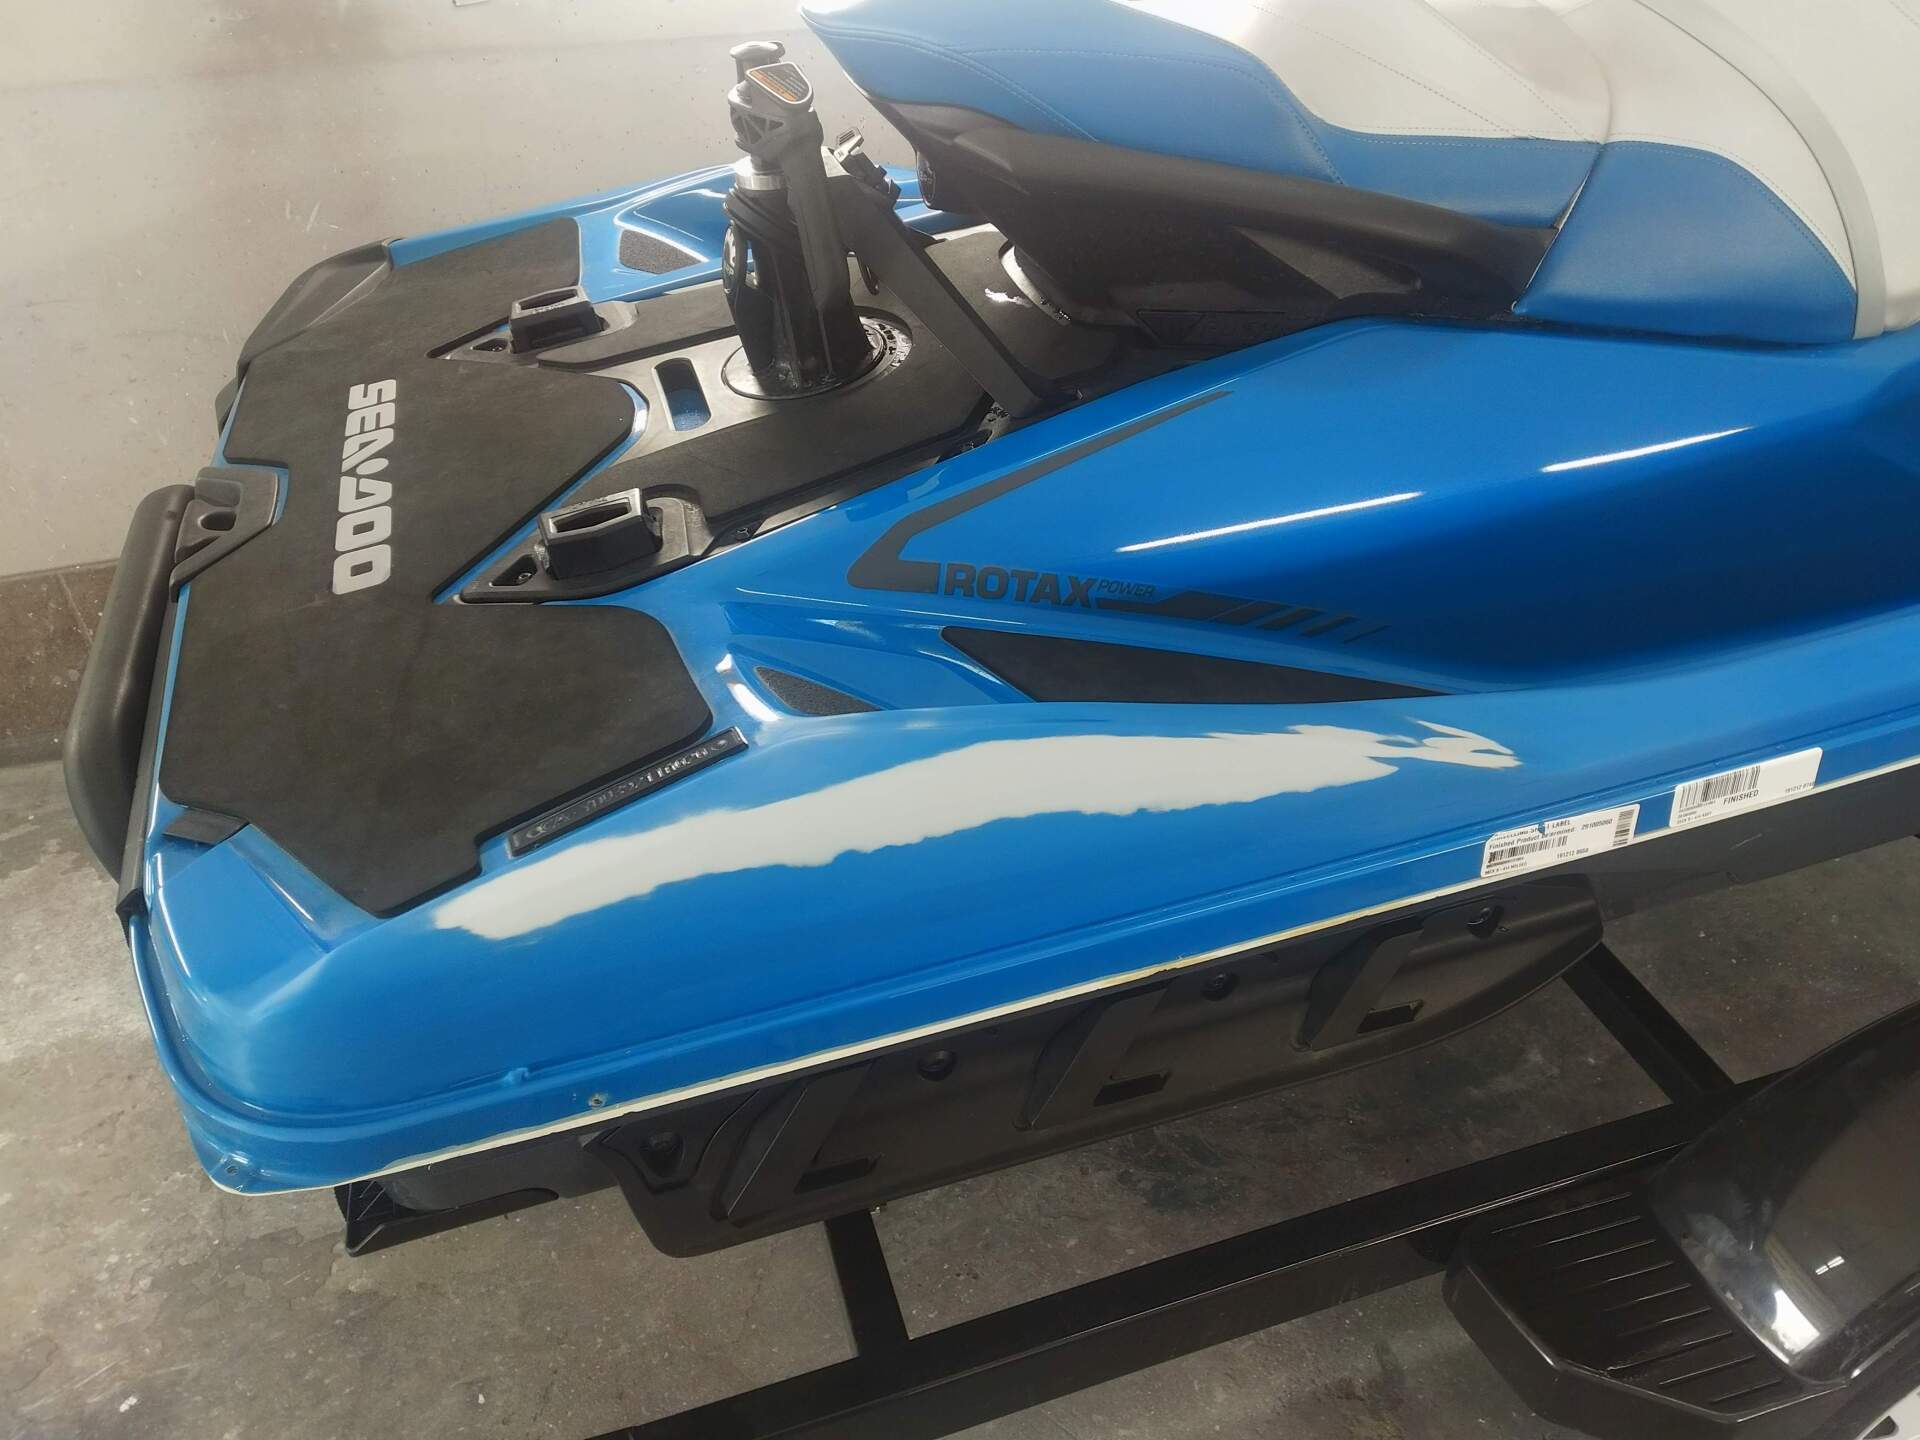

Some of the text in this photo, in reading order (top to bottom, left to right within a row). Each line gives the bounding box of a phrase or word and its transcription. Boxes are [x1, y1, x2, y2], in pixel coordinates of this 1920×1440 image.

[943, 561, 1156, 609] ROTAX POWER
[1723, 789, 1759, 806] FINISHED
[1553, 819, 1570, 829] LABEL
[1488, 839, 1515, 850] Finished
[1516, 833, 1540, 844] Product
